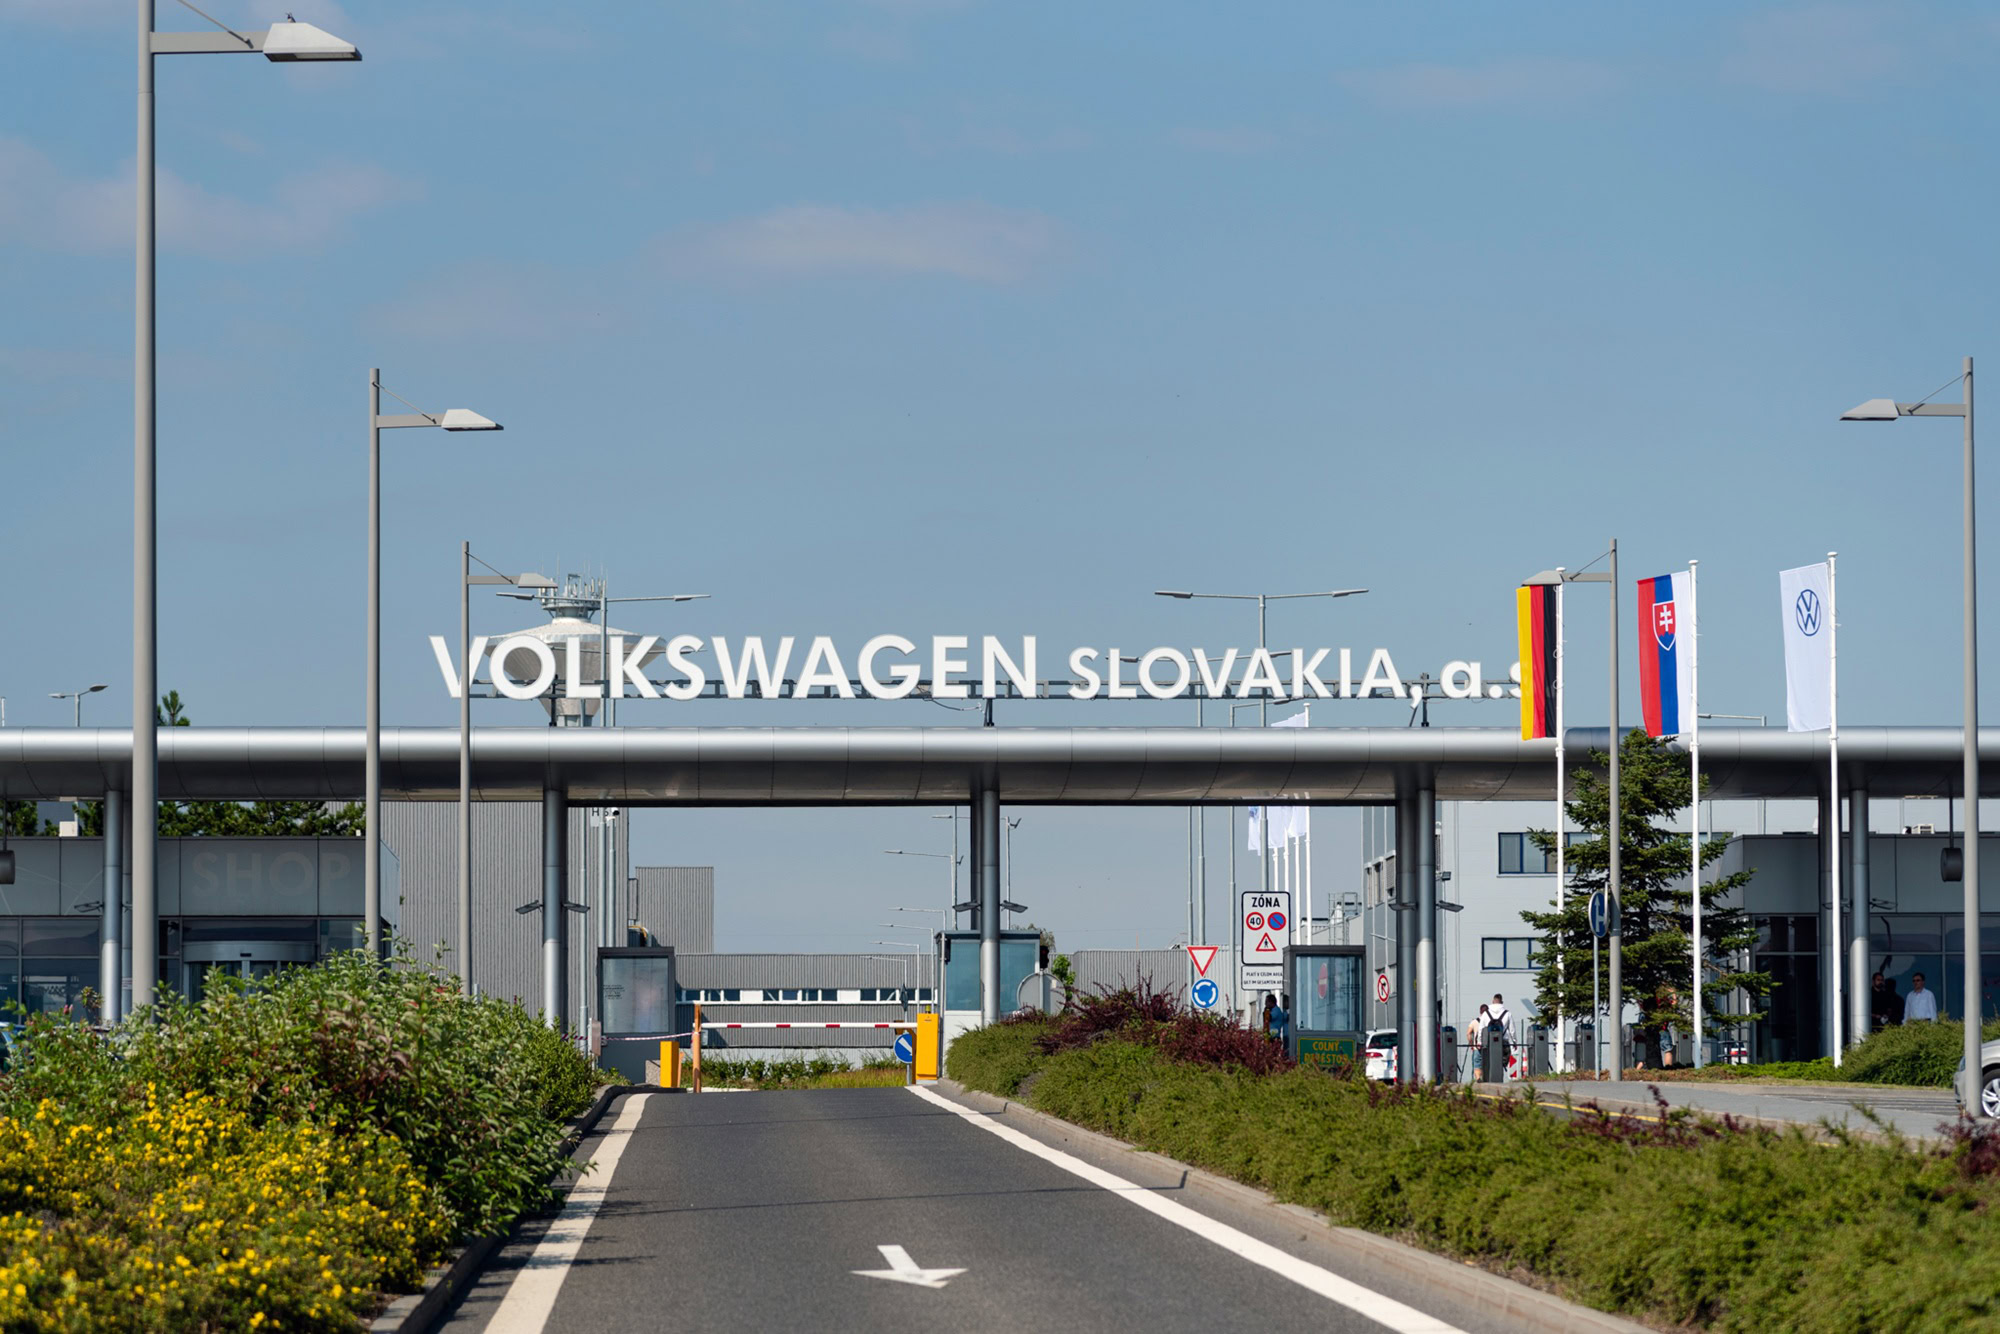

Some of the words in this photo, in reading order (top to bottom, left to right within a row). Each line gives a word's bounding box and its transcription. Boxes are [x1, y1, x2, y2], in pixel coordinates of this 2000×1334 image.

[428, 634, 1037, 700] VOLKSWAGEN
[1068, 647, 1422, 709] SLOVAKIA,
[191, 851, 352, 897] SHOP
[1251, 894, 1281, 908] ZÓNA
[1249, 917, 1262, 926] 40
